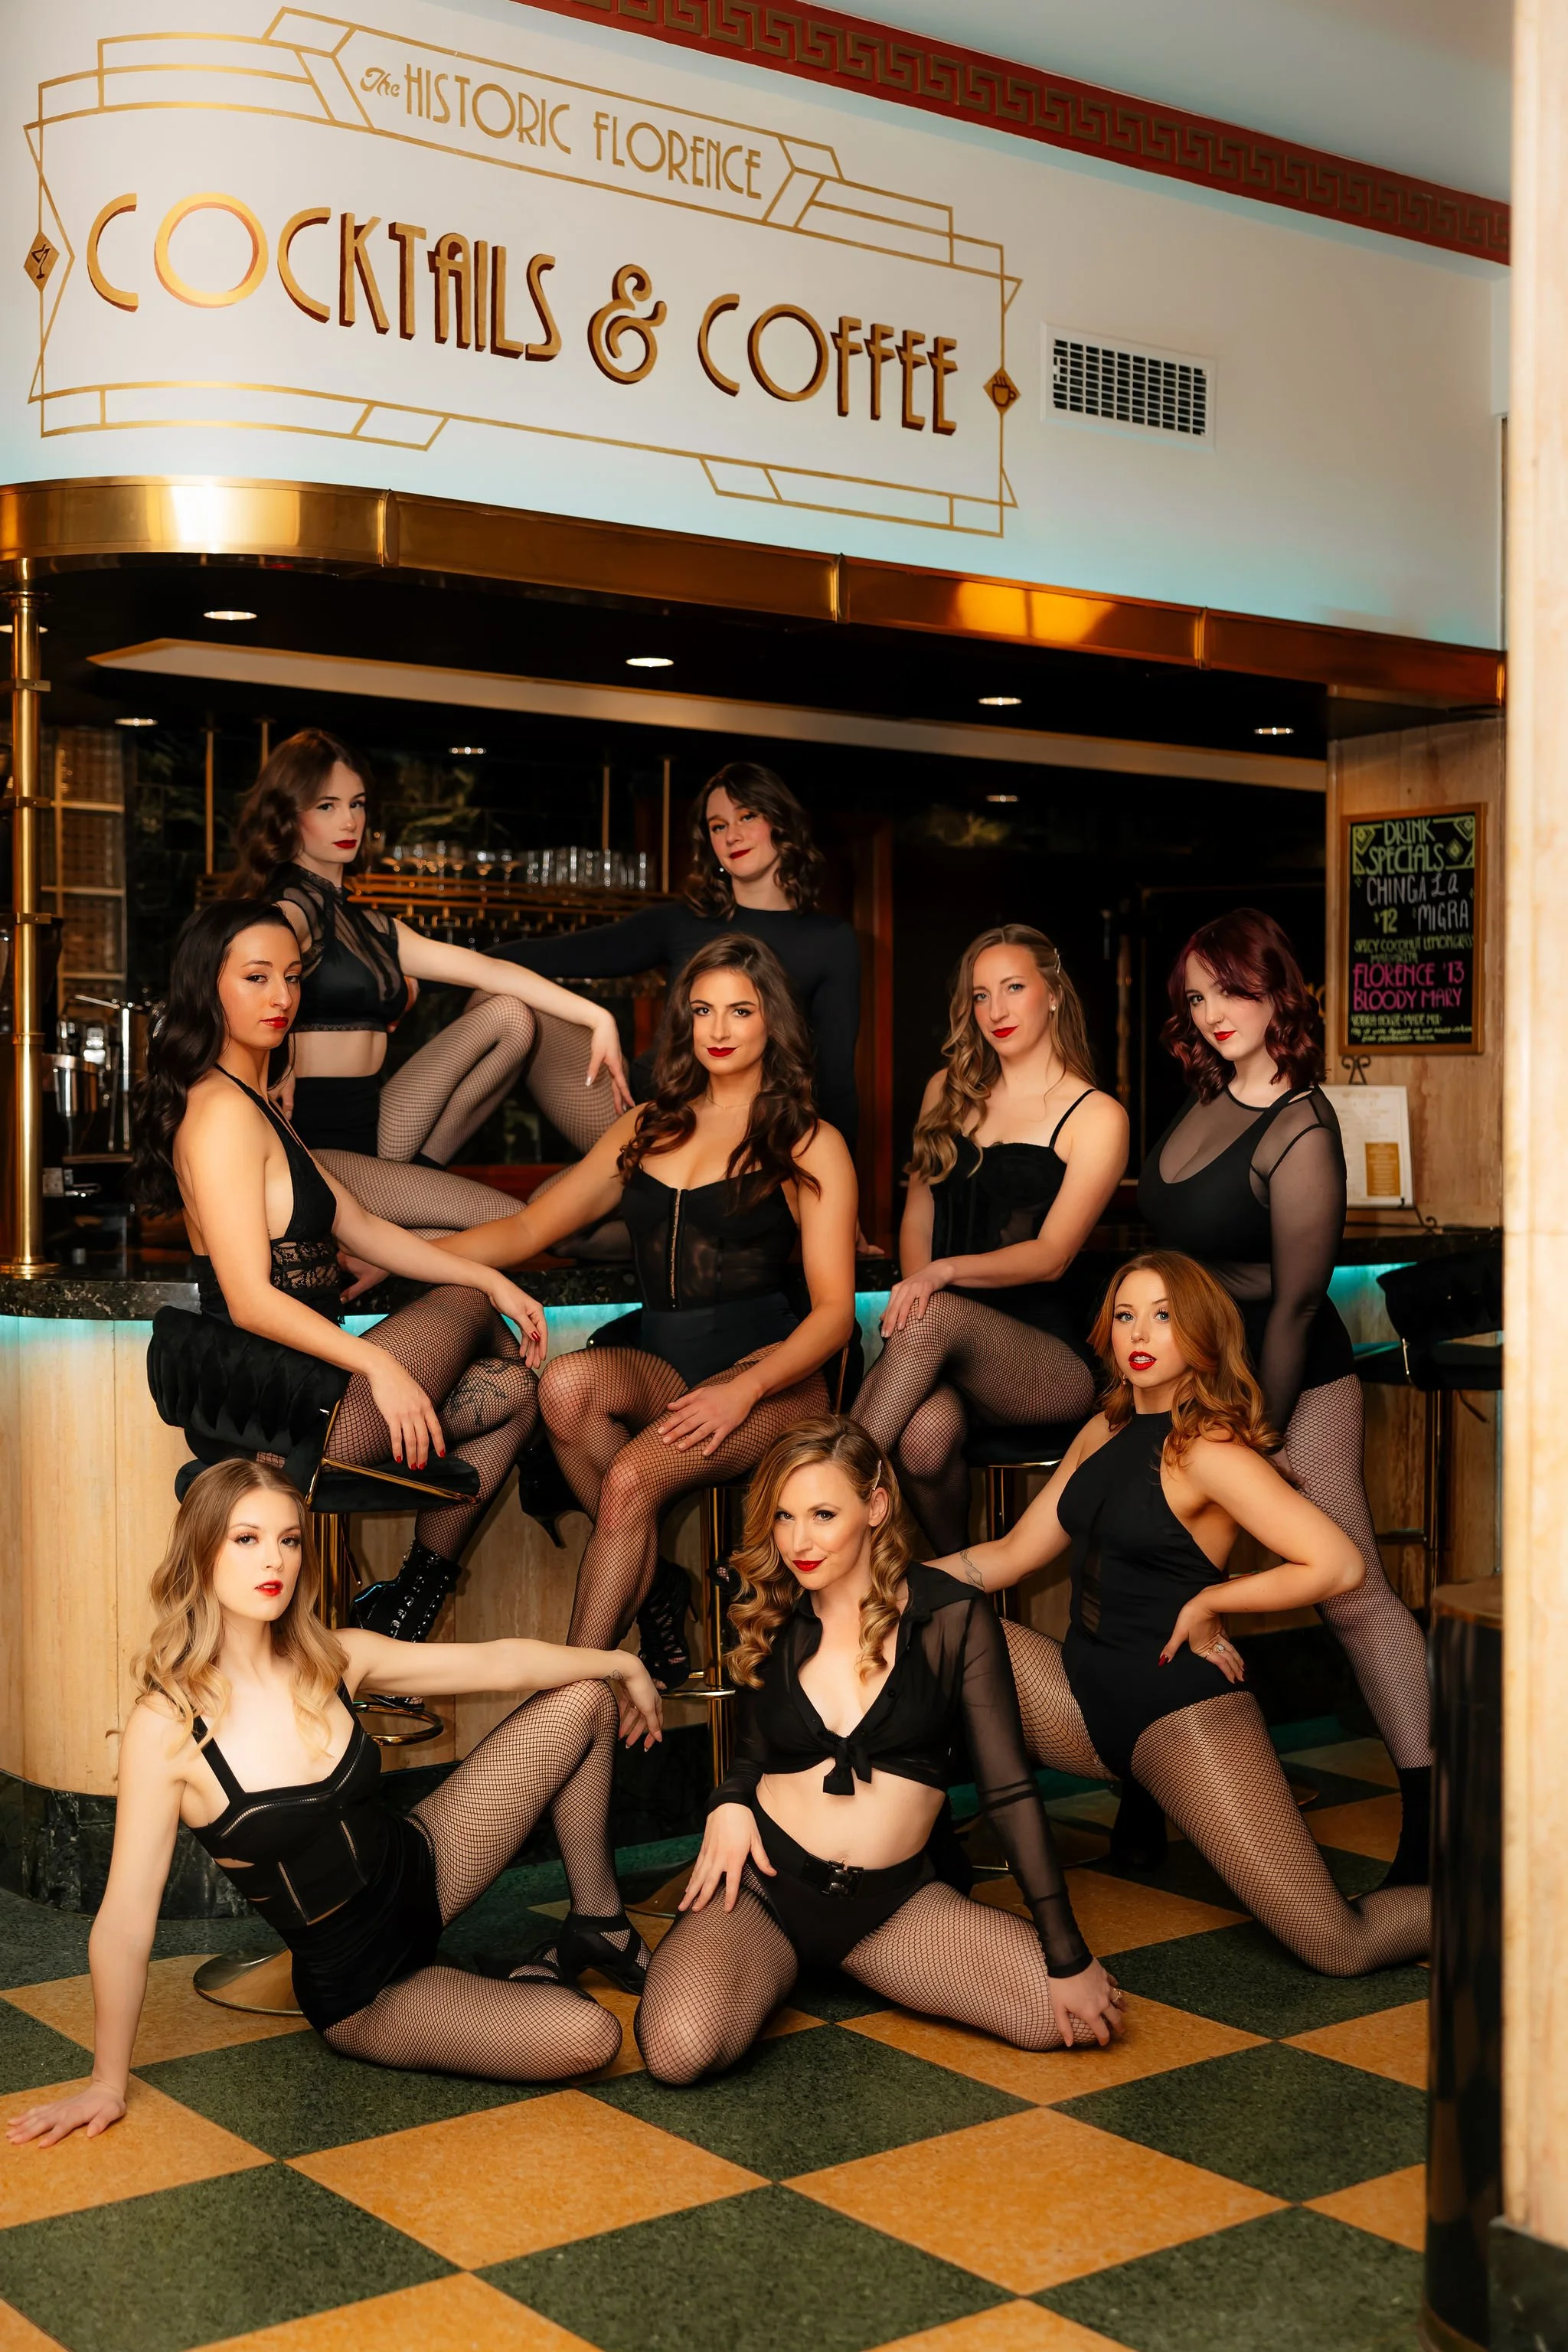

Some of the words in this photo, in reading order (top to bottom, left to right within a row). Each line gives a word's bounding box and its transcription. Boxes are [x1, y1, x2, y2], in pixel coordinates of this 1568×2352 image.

[360, 67, 400, 97] The
[404, 63, 571, 154] HISTORIC
[593, 111, 762, 199] FLORENCE
[87, 191, 561, 362] COCKTAILS
[587, 263, 667, 384] &
[697, 293, 958, 436] COFFEE
[1383, 818, 1436, 846] DRINK
[1365, 843, 1445, 875] SPECIALS
[1367, 874, 1426, 906] CHINGA
[1417, 899, 1469, 932] MIGRA
[1353, 962, 1436, 989] FLORENCE
[1353, 988, 1417, 1011] BLOODY
[1420, 987, 1462, 1008] MARY
